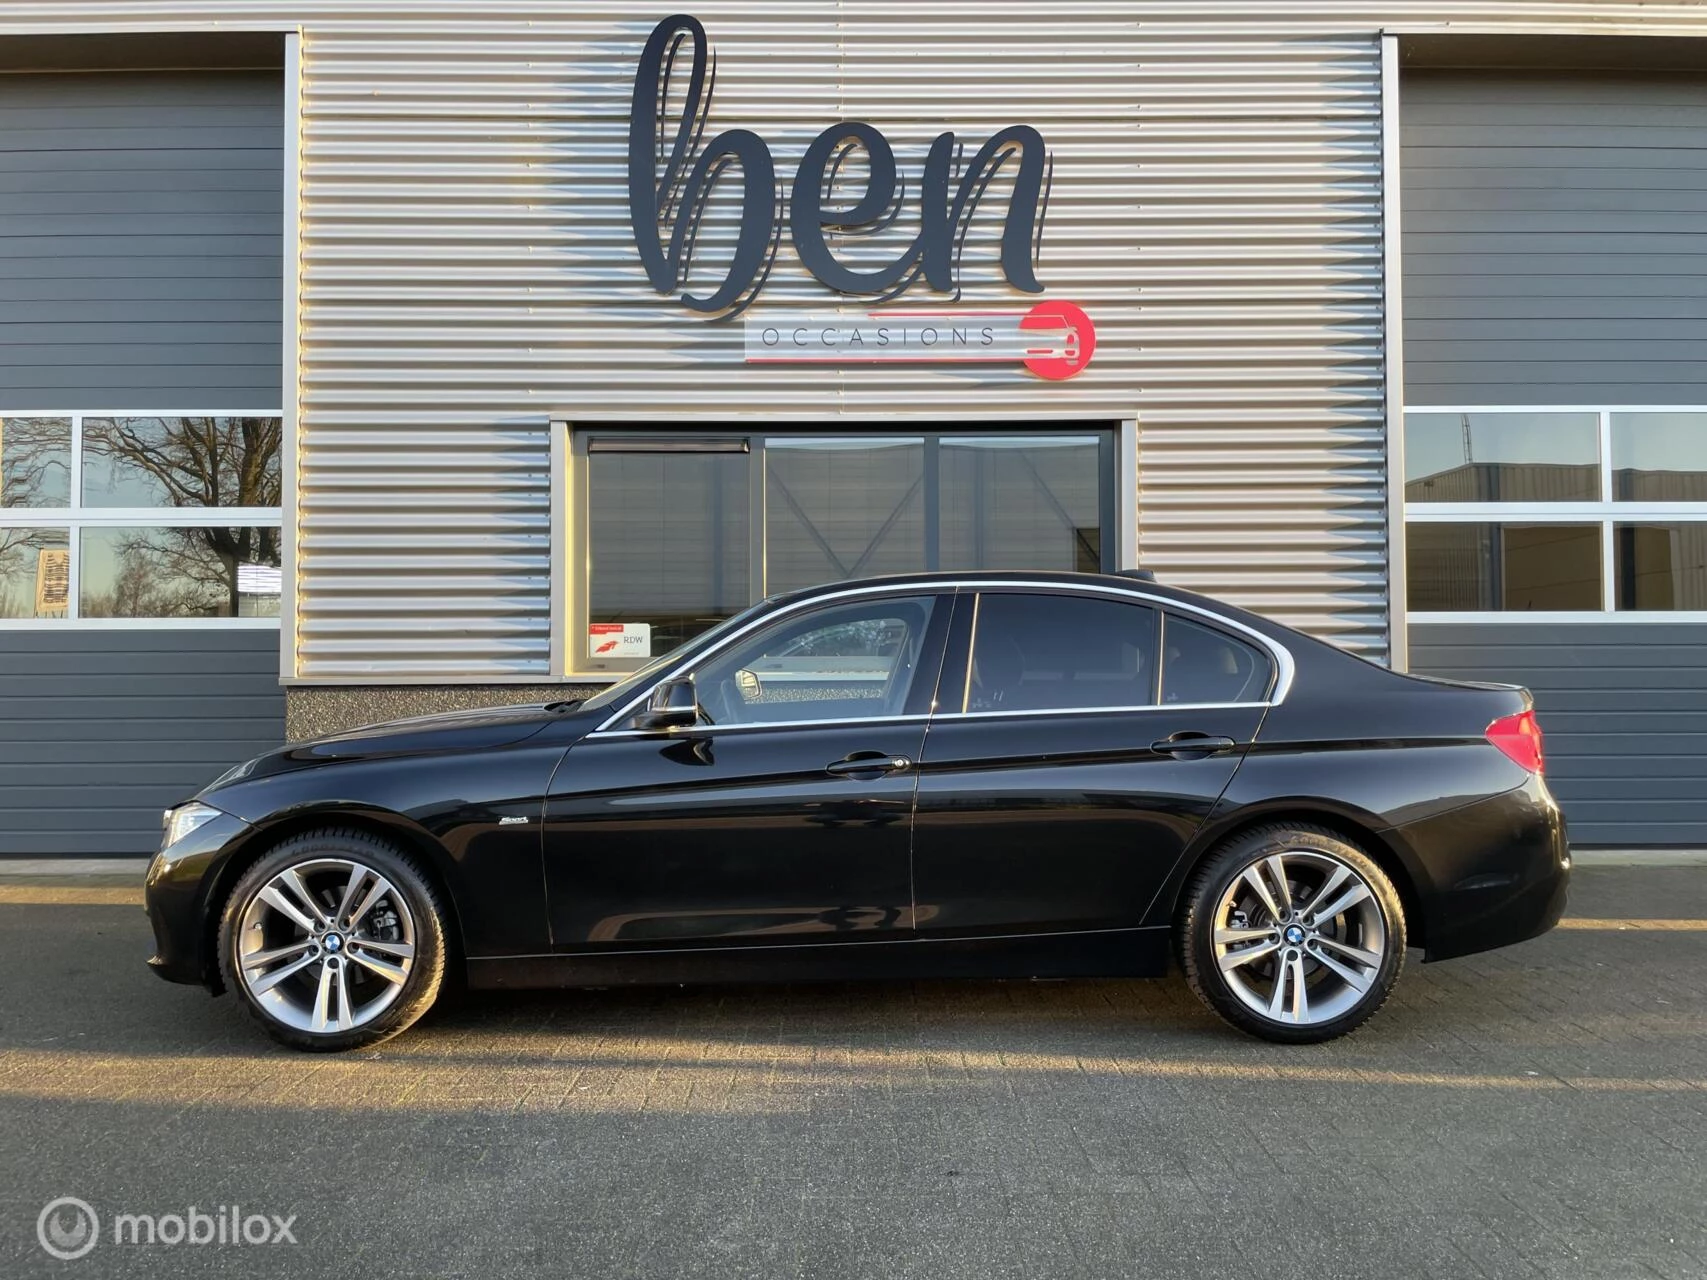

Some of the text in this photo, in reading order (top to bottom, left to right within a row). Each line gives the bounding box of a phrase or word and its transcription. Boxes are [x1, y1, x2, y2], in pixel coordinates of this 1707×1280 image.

[629, 14, 1053, 321] ben
[761, 327, 994, 346] OCCASIONS
[623, 636, 643, 644] RDW
